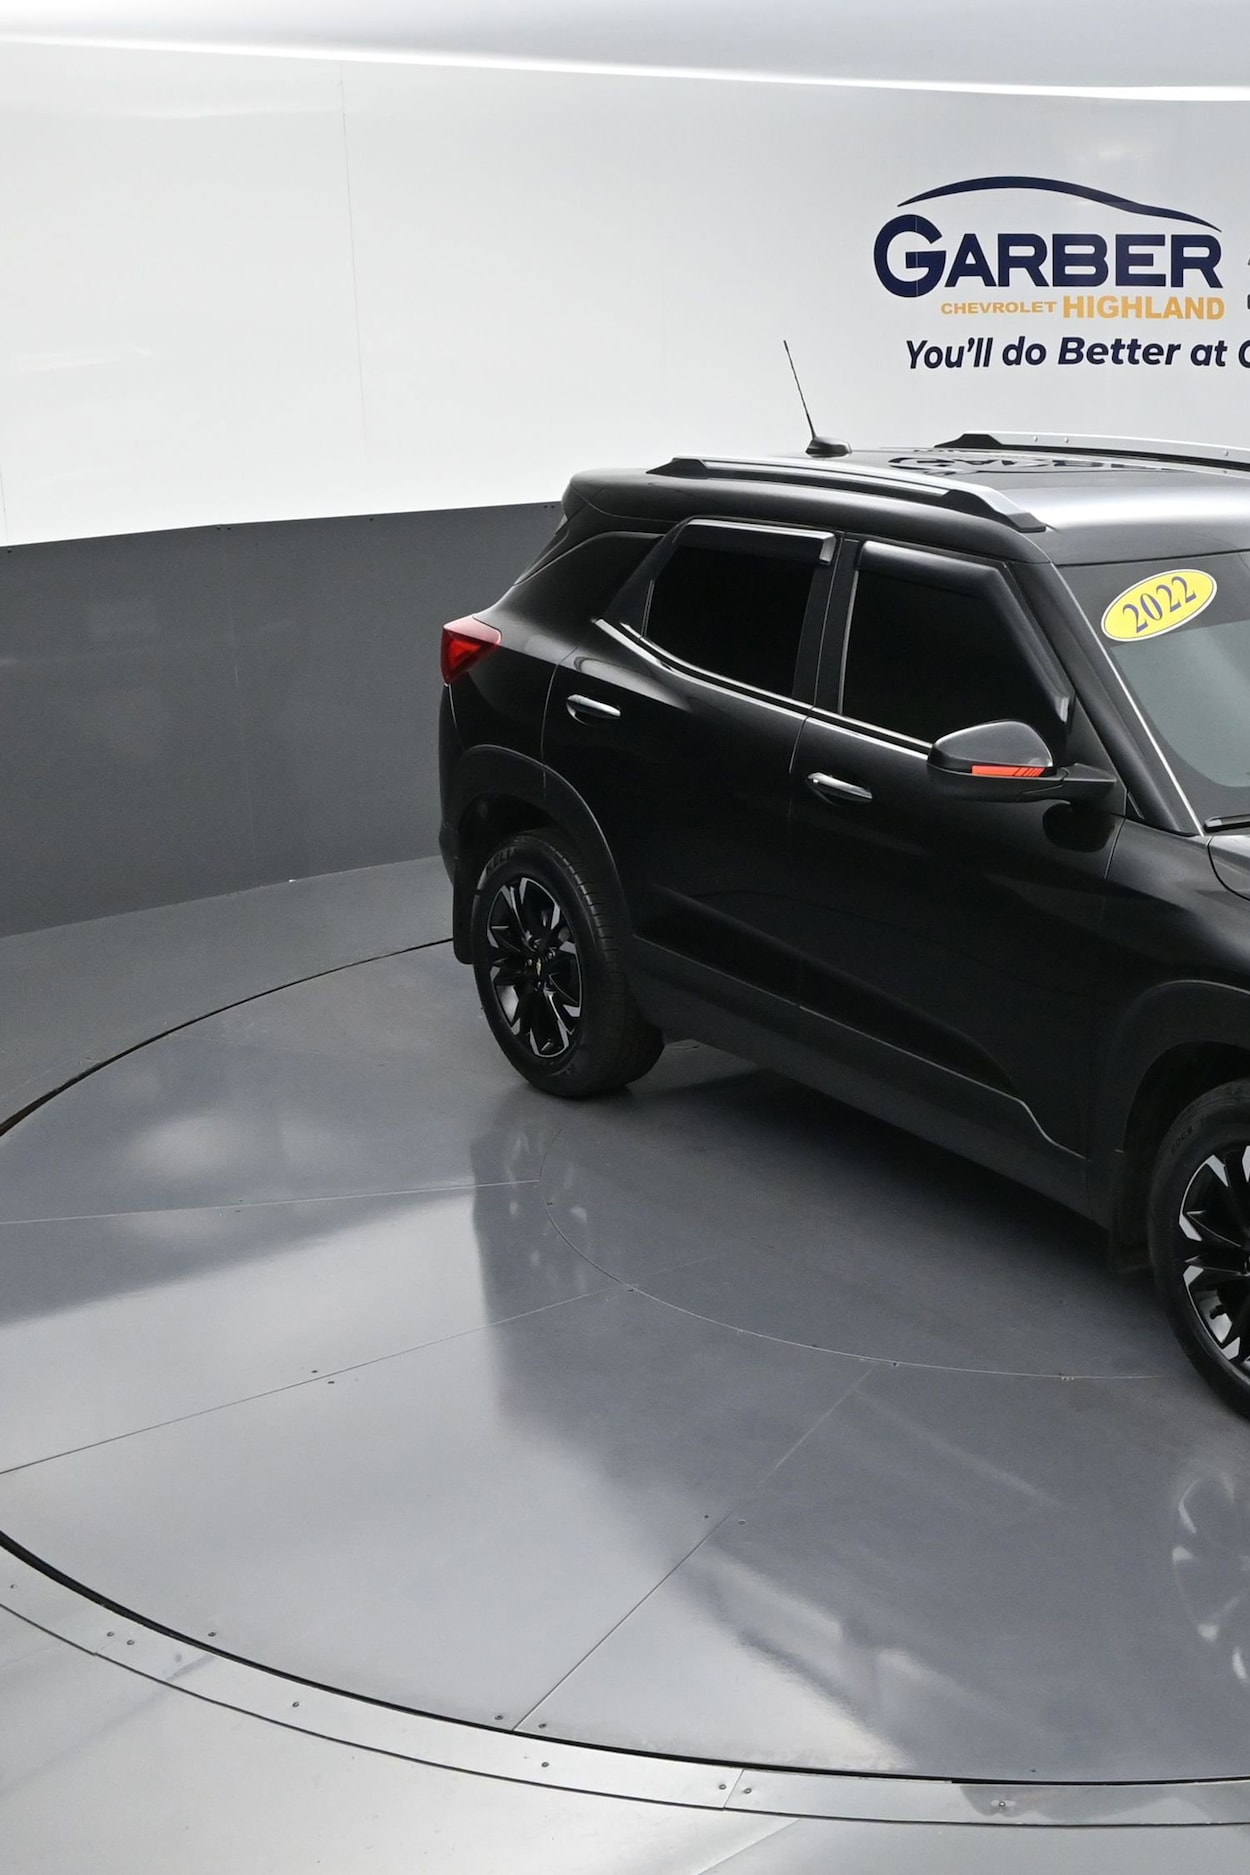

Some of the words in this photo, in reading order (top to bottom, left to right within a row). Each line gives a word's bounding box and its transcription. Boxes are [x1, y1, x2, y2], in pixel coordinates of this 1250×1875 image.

[873, 214, 1224, 298] GARBER
[941, 301, 1057, 314] CHEVROLET
[1063, 295, 1225, 320] HIGHLAND
[1002, 336, 1047, 366] do
[1058, 337, 1181, 366] Better
[1190, 340, 1228, 367] at
[1122, 576, 1197, 633] 2022
